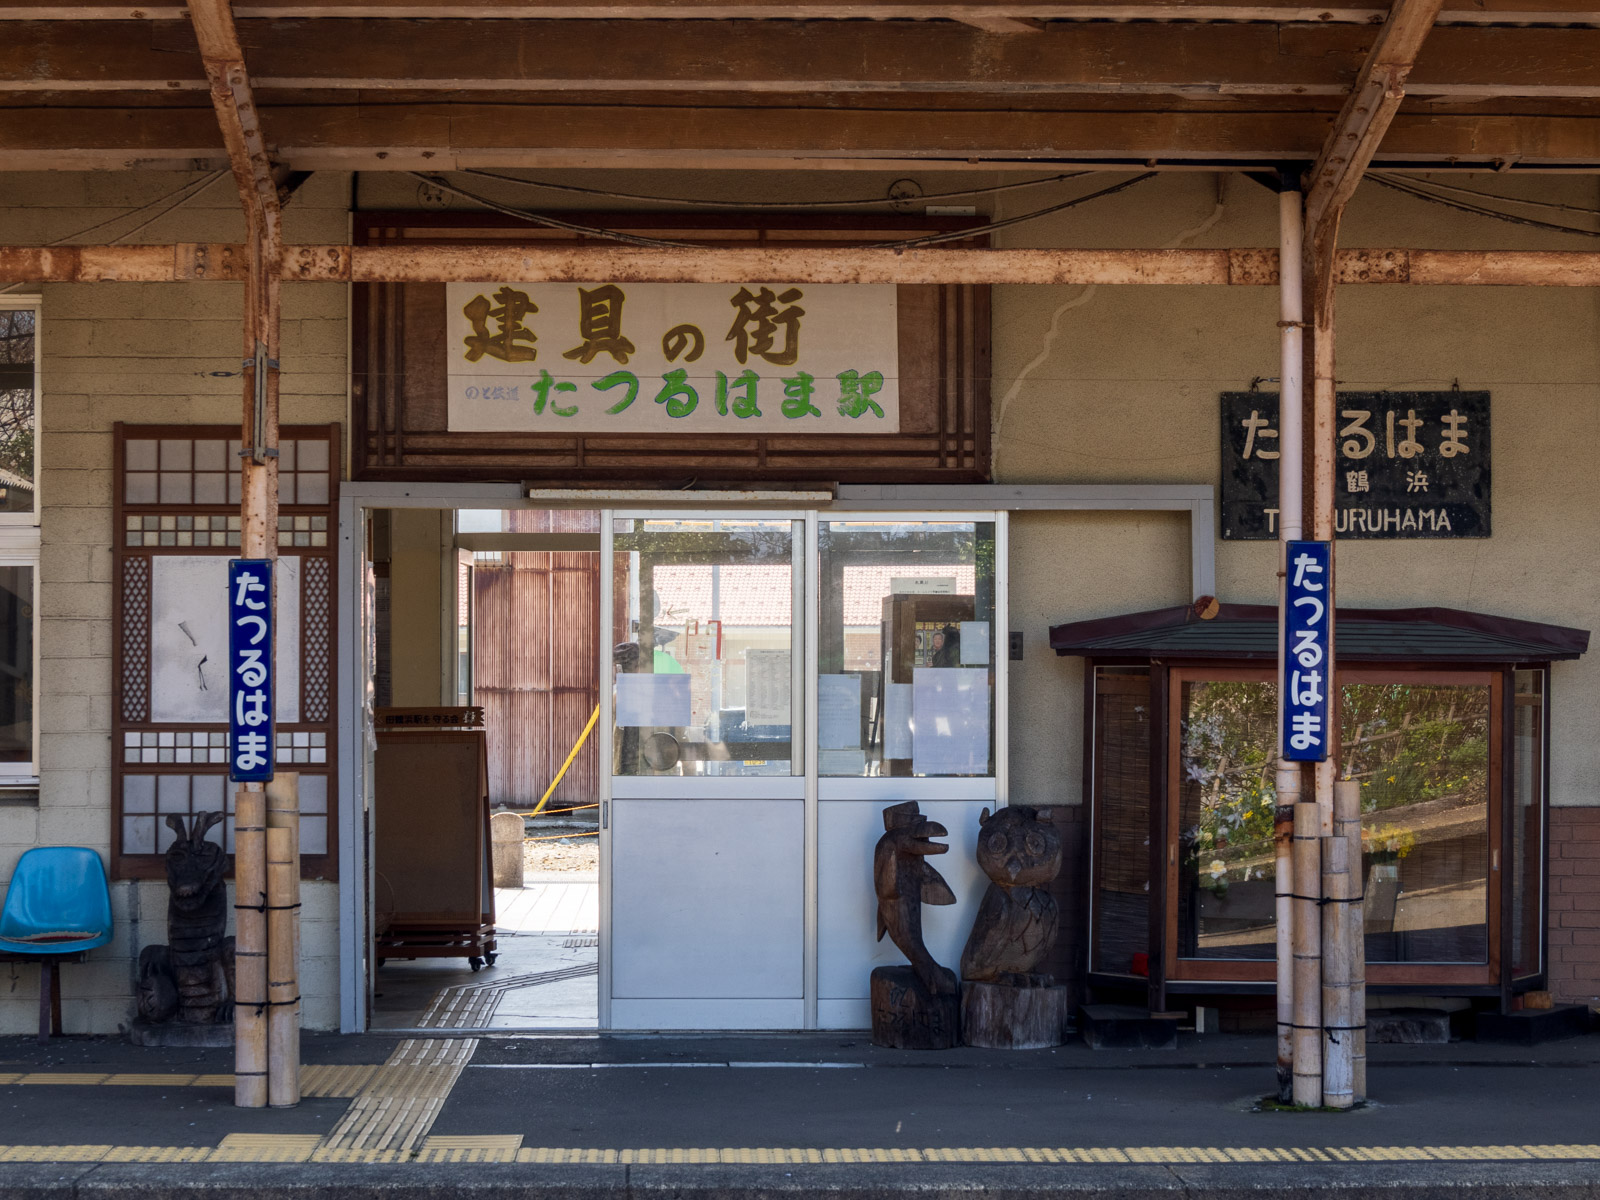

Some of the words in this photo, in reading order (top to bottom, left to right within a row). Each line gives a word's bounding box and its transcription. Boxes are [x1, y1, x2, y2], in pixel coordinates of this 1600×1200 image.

[463, 284, 806, 367] 建具の街
[531, 368, 885, 419] たつるはま駅
[1242, 409, 1470, 459] たるはま
[1346, 470, 1429, 493] 鶴浜
[1263, 508, 1452, 533] TURUHAMA
[235, 571, 269, 771] たつるはま
[1289, 553, 1325, 751] たつるはま
